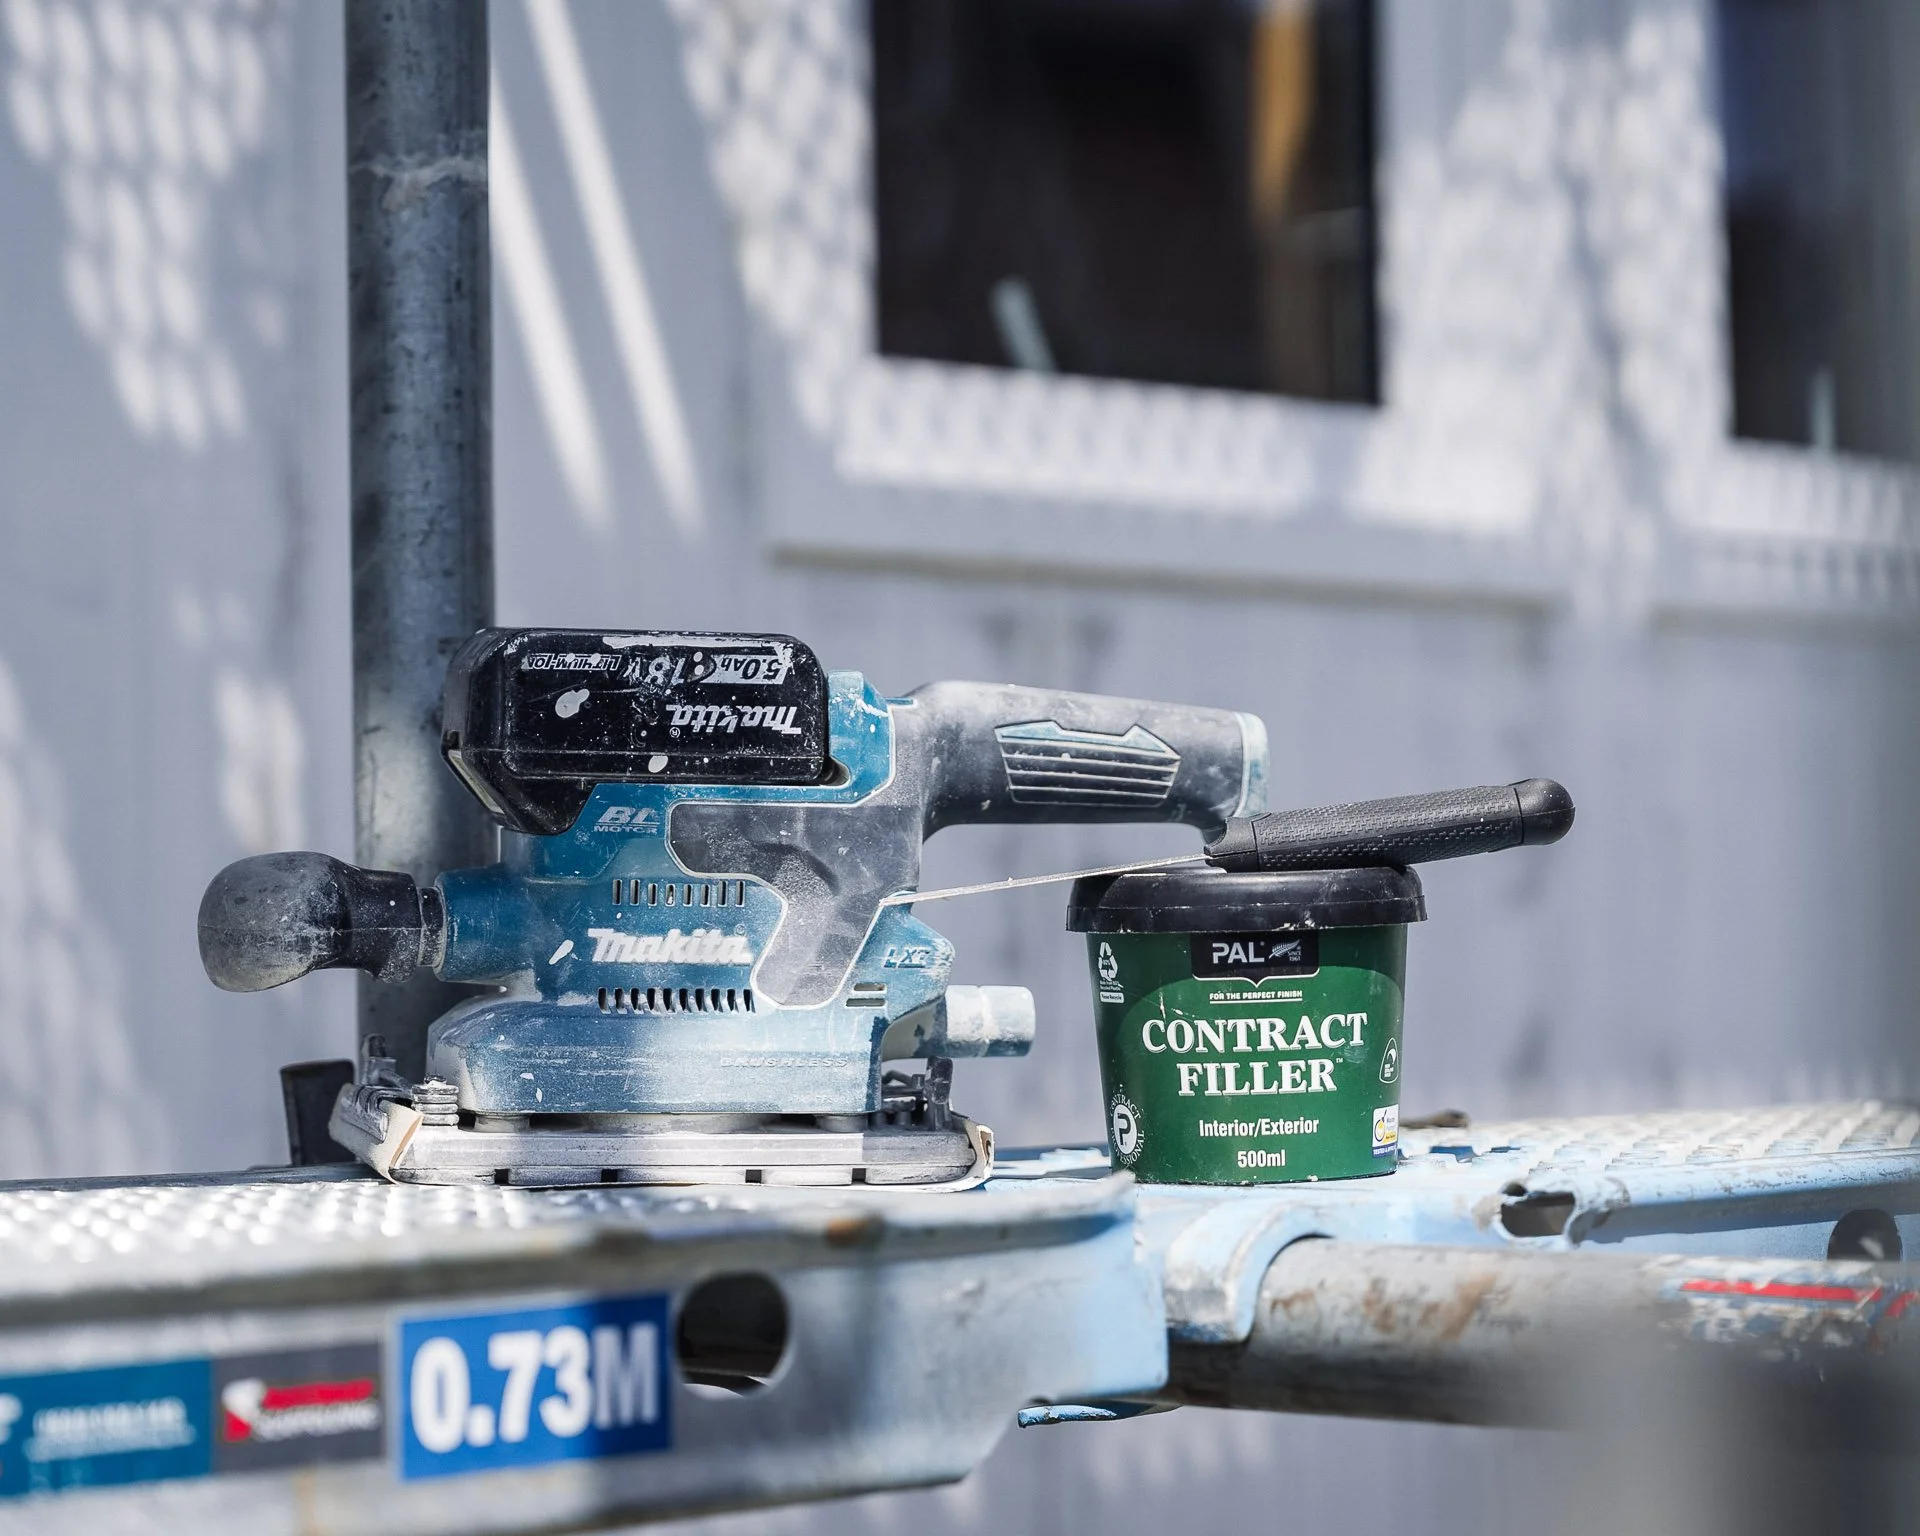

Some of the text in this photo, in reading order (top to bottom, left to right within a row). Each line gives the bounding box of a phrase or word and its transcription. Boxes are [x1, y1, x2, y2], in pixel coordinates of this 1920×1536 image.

[720, 658, 783, 681] 5.0Ah
[1212, 942, 1265, 964] PAL
[1209, 990, 1303, 1000] FOR THE PERFECT FINISH
[1142, 1013, 1368, 1053] CONTRACT
[1176, 1059, 1337, 1096] FILLER
[1199, 1117, 1320, 1138] Interior/Exterior
[1237, 1150, 1287, 1168] 500ml
[410, 1320, 659, 1453] 0.73M
